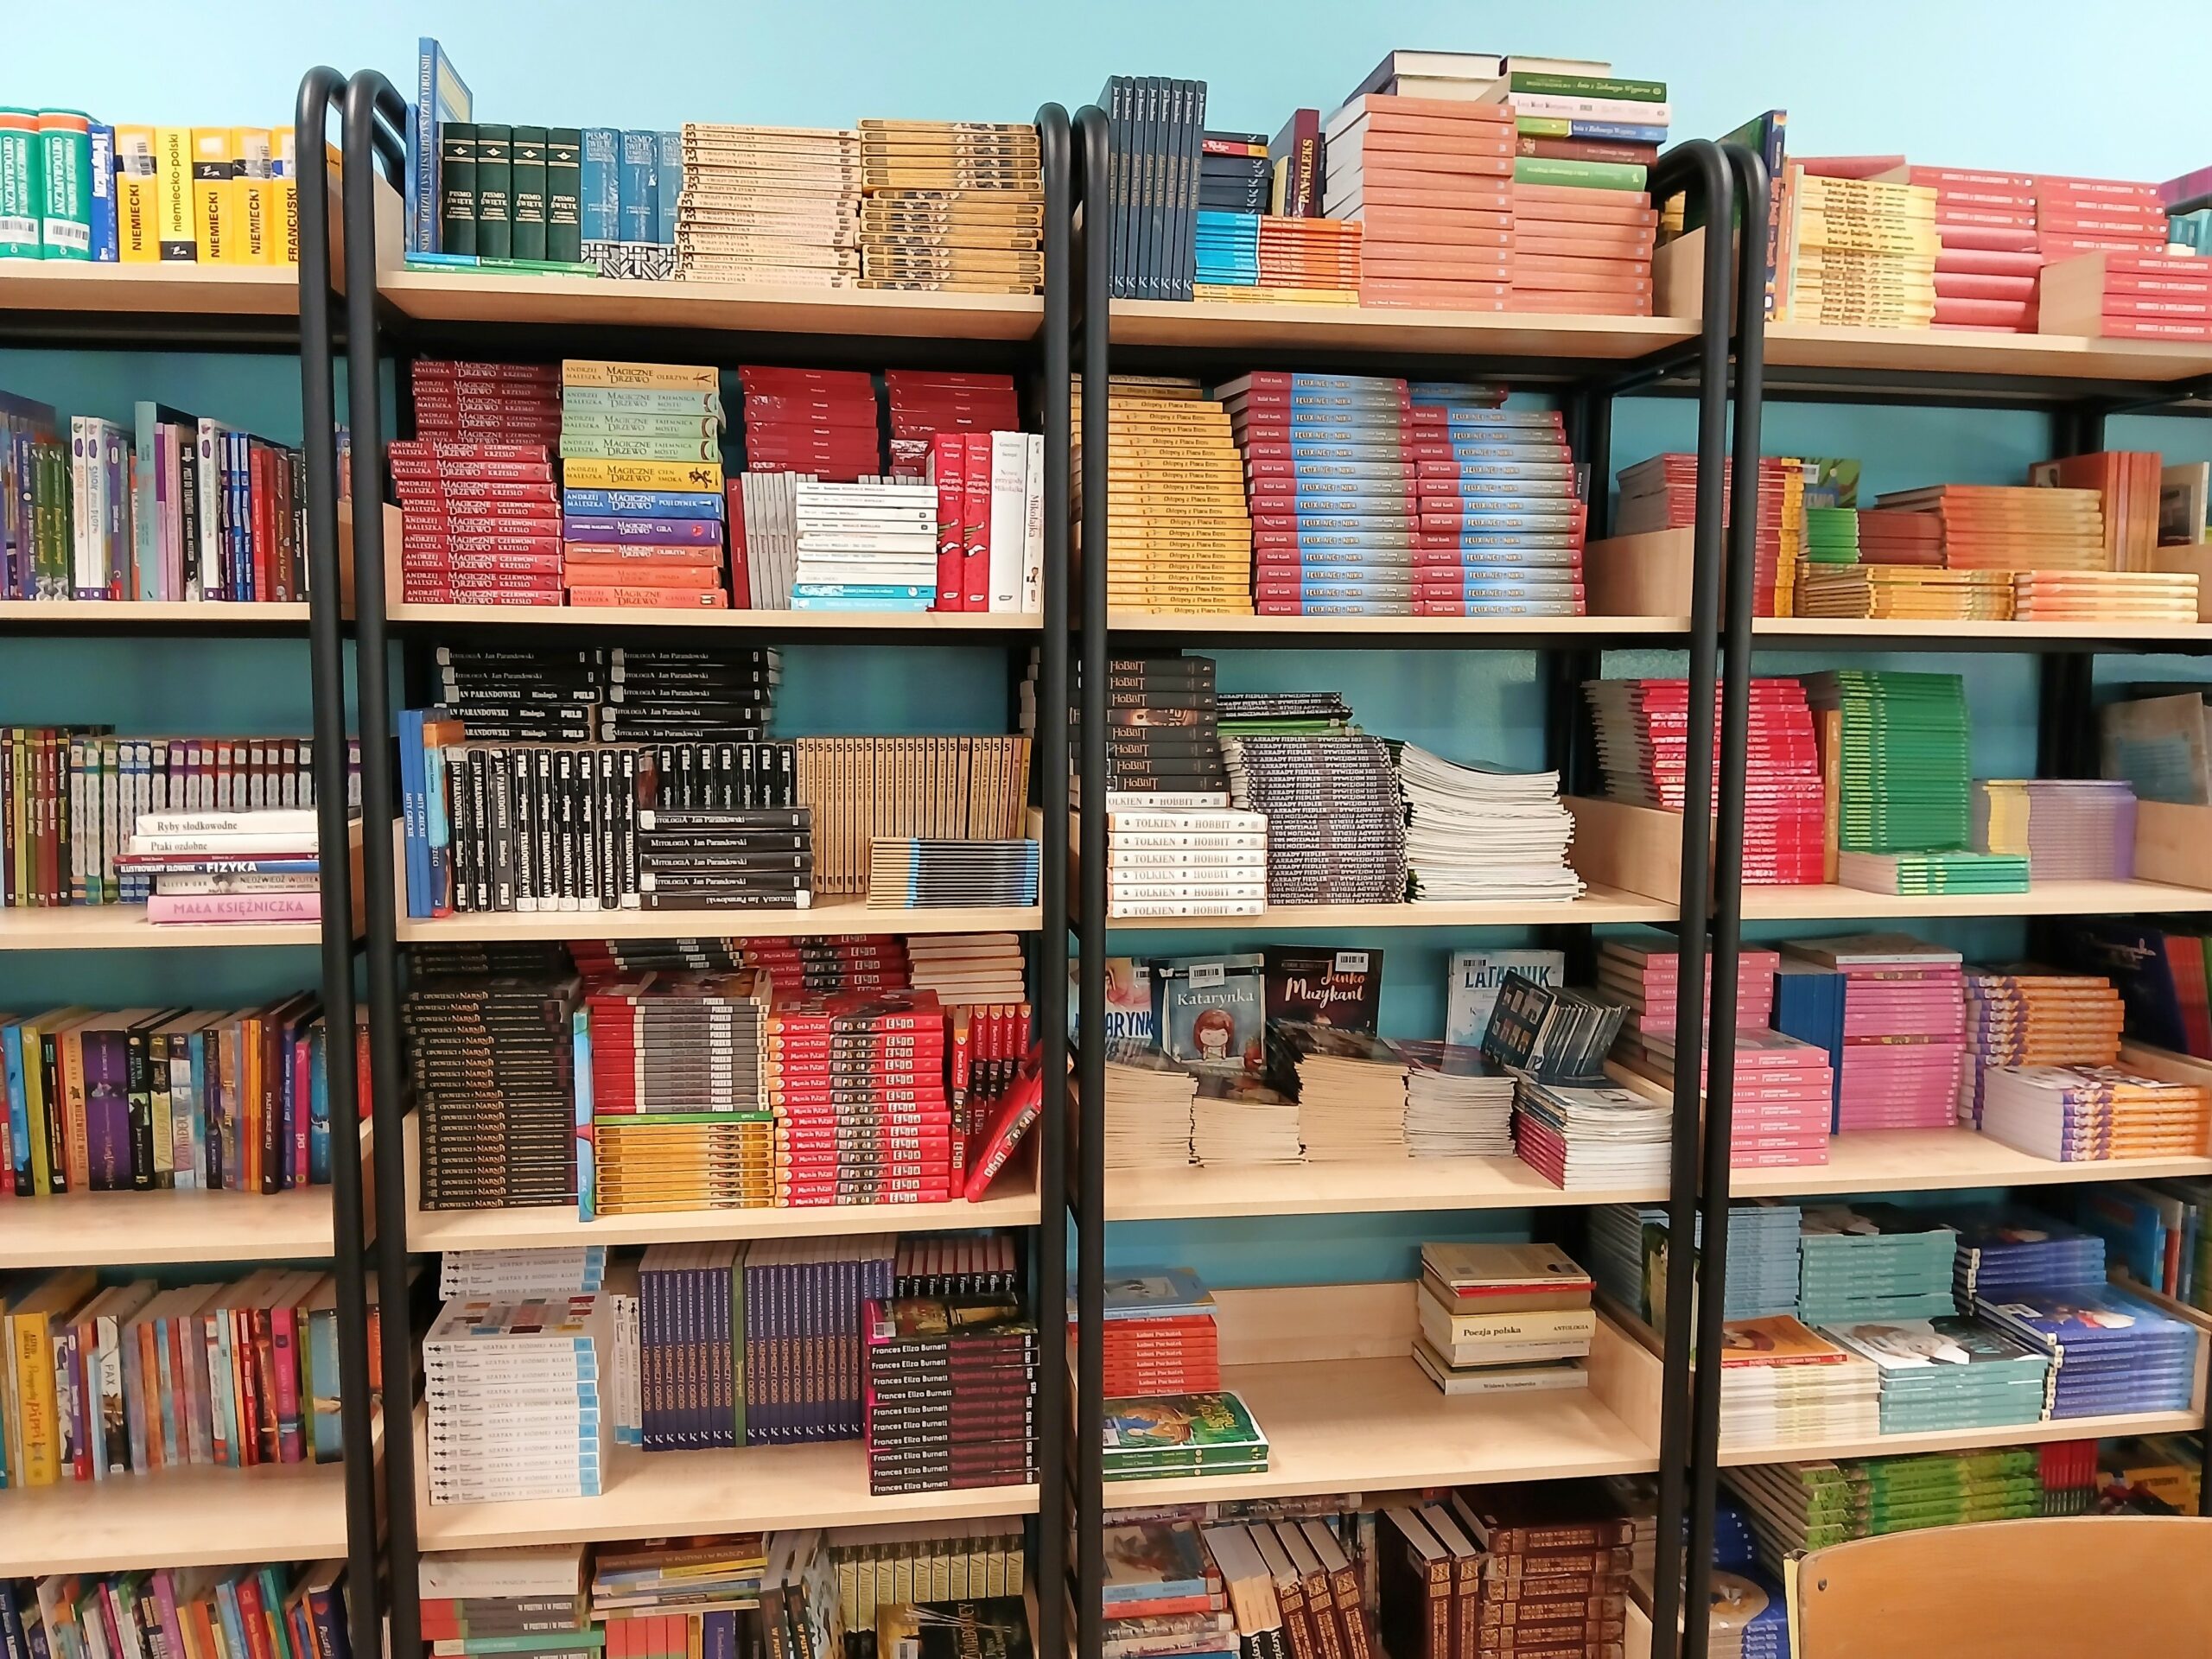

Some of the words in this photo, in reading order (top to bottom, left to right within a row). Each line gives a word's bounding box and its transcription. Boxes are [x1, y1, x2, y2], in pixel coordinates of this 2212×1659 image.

[586, 132, 612, 141] PISMO
[625, 135, 653, 143] PISMO
[170, 133, 181, 232] niemiecko-polski
[131, 184, 142, 251] NIEMIECKI
[251, 188, 260, 255] NIEMIECKI
[210, 192, 219, 257] NIEMIECKI
[288, 188, 297, 263] FRANCUSKI
[607, 366, 653, 376] MAGICZNE
[610, 375, 650, 384] DRZEWO
[433, 442, 478, 451] MAGICZNE
[603, 439, 650, 448] MAGICZNE
[436, 448, 474, 458] DRZEWO
[607, 465, 654, 474] MAGICZNE
[607, 493, 656, 503] MAGICZNE
[612, 501, 652, 511] DRZEWO
[798, 742, 804, 751] 5
[827, 743, 832, 752] 5
[887, 743, 893, 752] 5
[960, 742, 969, 752] 18
[1004, 742, 1010, 752] 5
[452, 762, 461, 775] JAN
[454, 778, 462, 829] PARANDOWSKI
[157, 822, 180, 833] Ryby
[182, 821, 238, 830] słodkowodne
[1135, 819, 1177, 828] TOLKIEN
[1195, 820, 1231, 829] HOBBIT
[150, 842, 173, 850] Ptaki
[1135, 837, 1176, 846] TOLKIEN
[207, 861, 257, 873] FIZYKA
[173, 902, 212, 914] MAŁA
[218, 899, 304, 916] KSIĘŻNICZKA
[1133, 906, 1175, 915] TOLKIEN
[1321, 959, 1365, 986] Janko
[1285, 977, 1365, 1008] Muzykant
[1177, 988, 1255, 1008] Katarynka
[1493, 1326, 1522, 1335] polska
[105, 1364, 115, 1385] PAX
